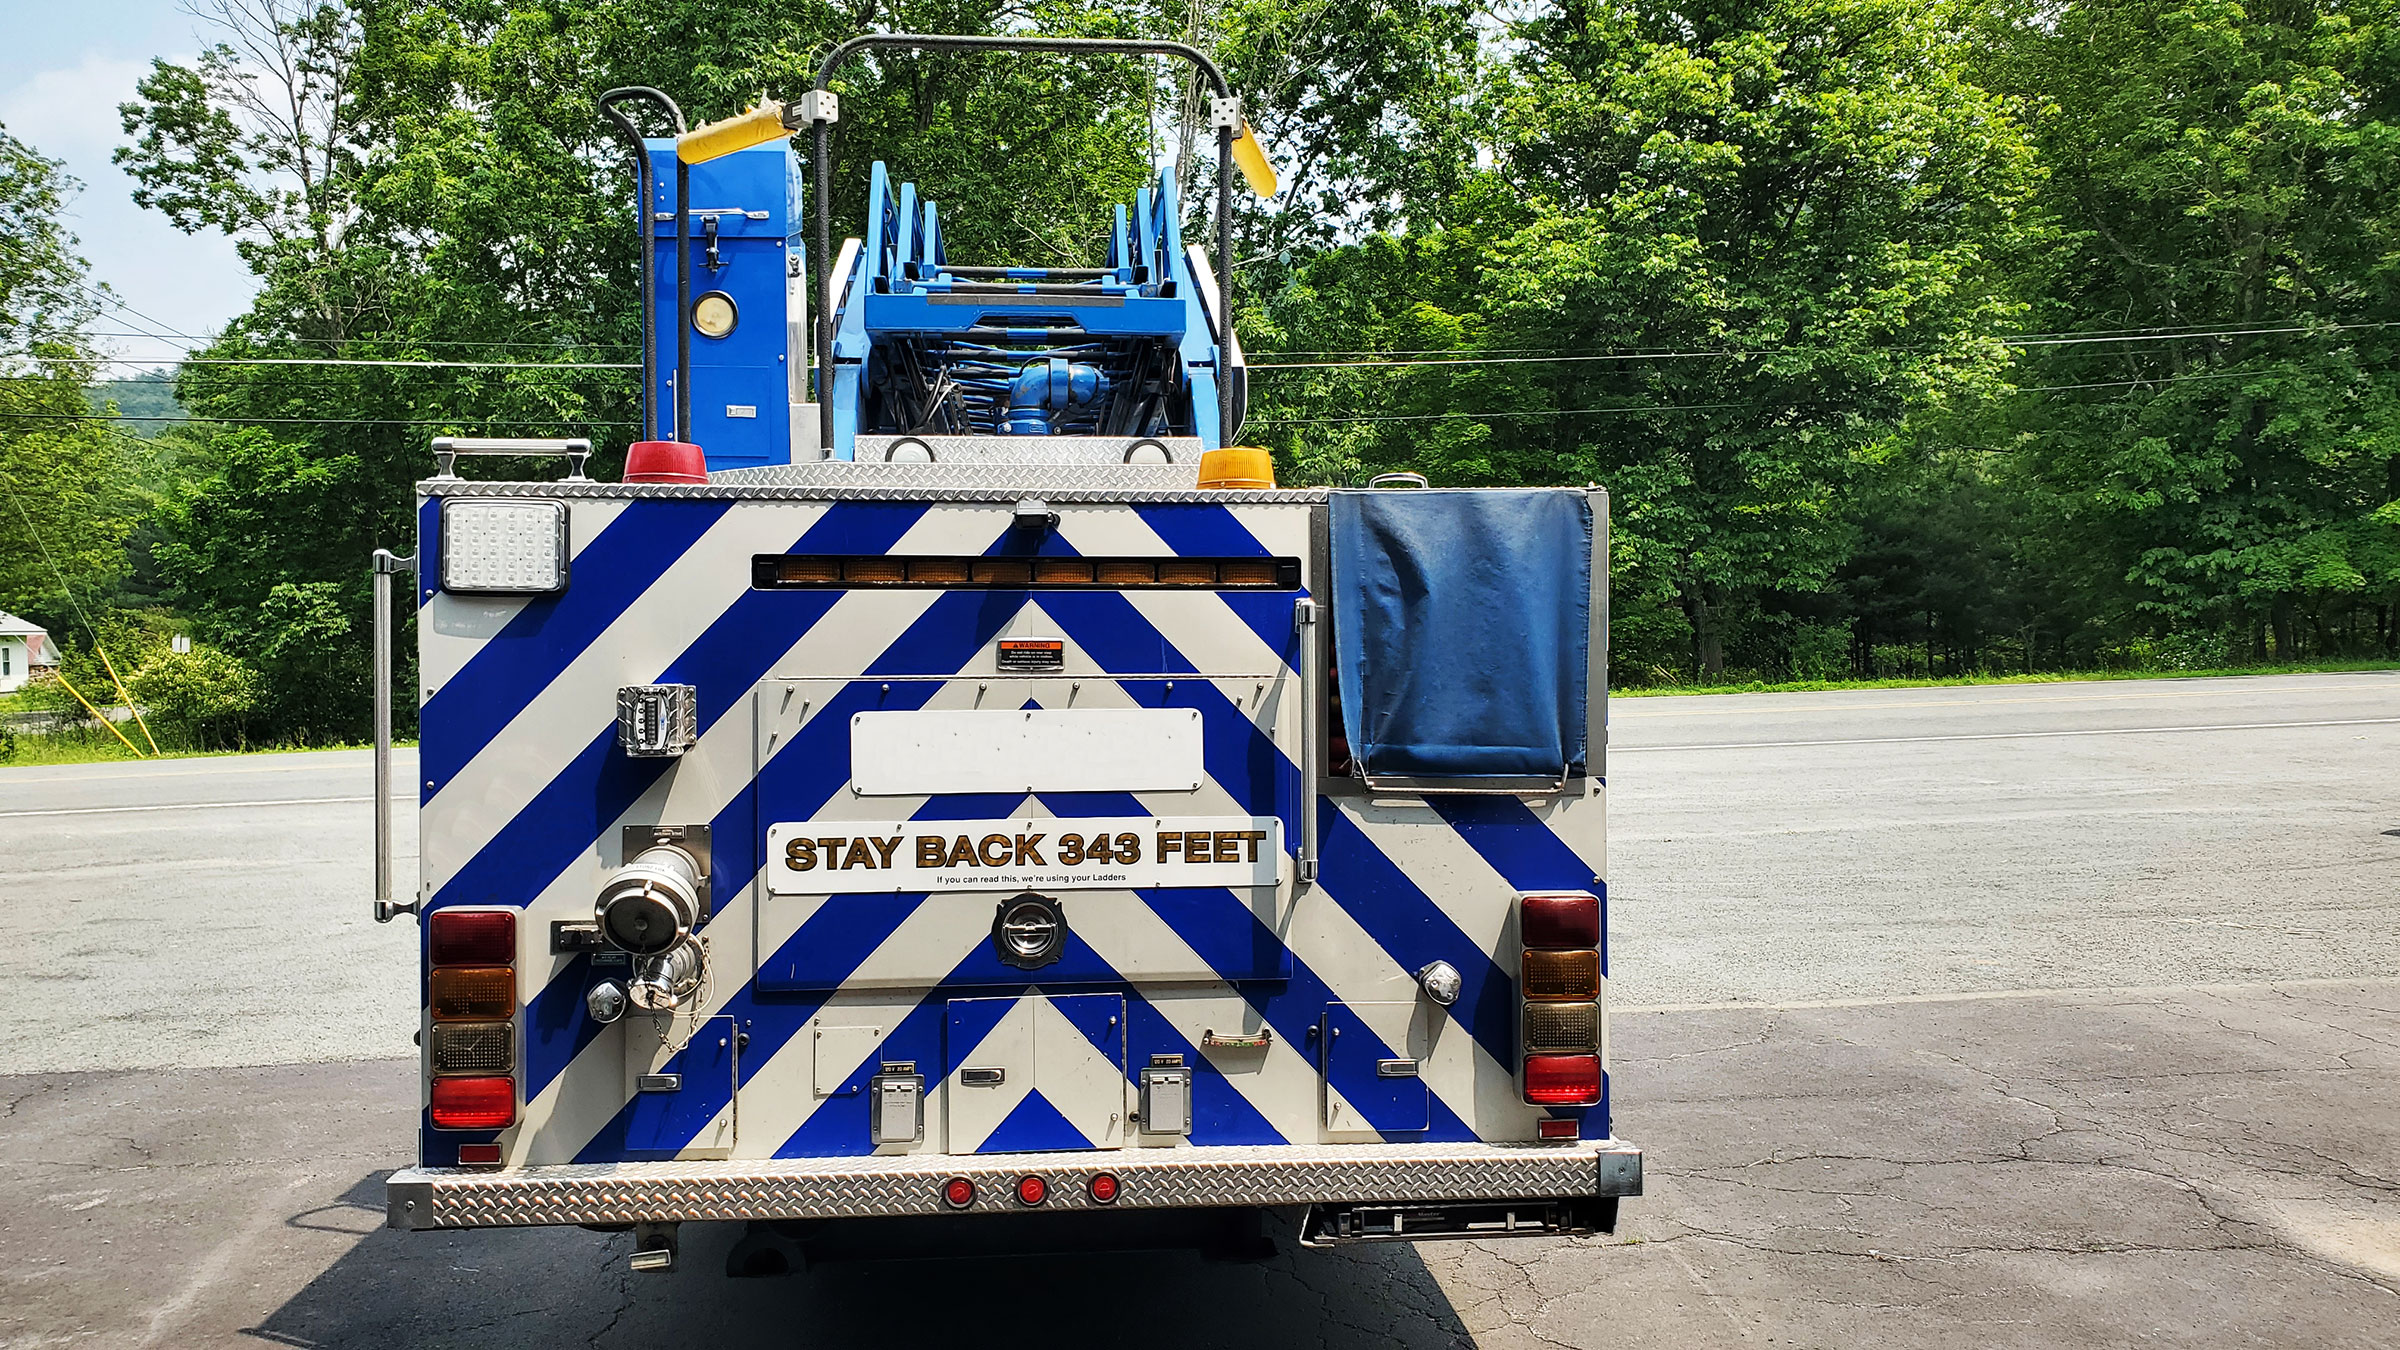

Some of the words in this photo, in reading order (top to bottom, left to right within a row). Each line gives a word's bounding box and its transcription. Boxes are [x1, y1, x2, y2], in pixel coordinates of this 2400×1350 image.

[784, 836, 905, 871] STAY
[915, 834, 1048, 869] BACK
[1057, 833, 1142, 867] 343
[1156, 831, 1267, 865] FEET
[936, 875, 943, 883] If
[945, 877, 961, 885] you
[980, 875, 999, 883] read
[1001, 875, 1020, 884] this,
[1046, 874, 1069, 883] using
[1072, 875, 1090, 883] your
[1092, 873, 1127, 882] Ladders
